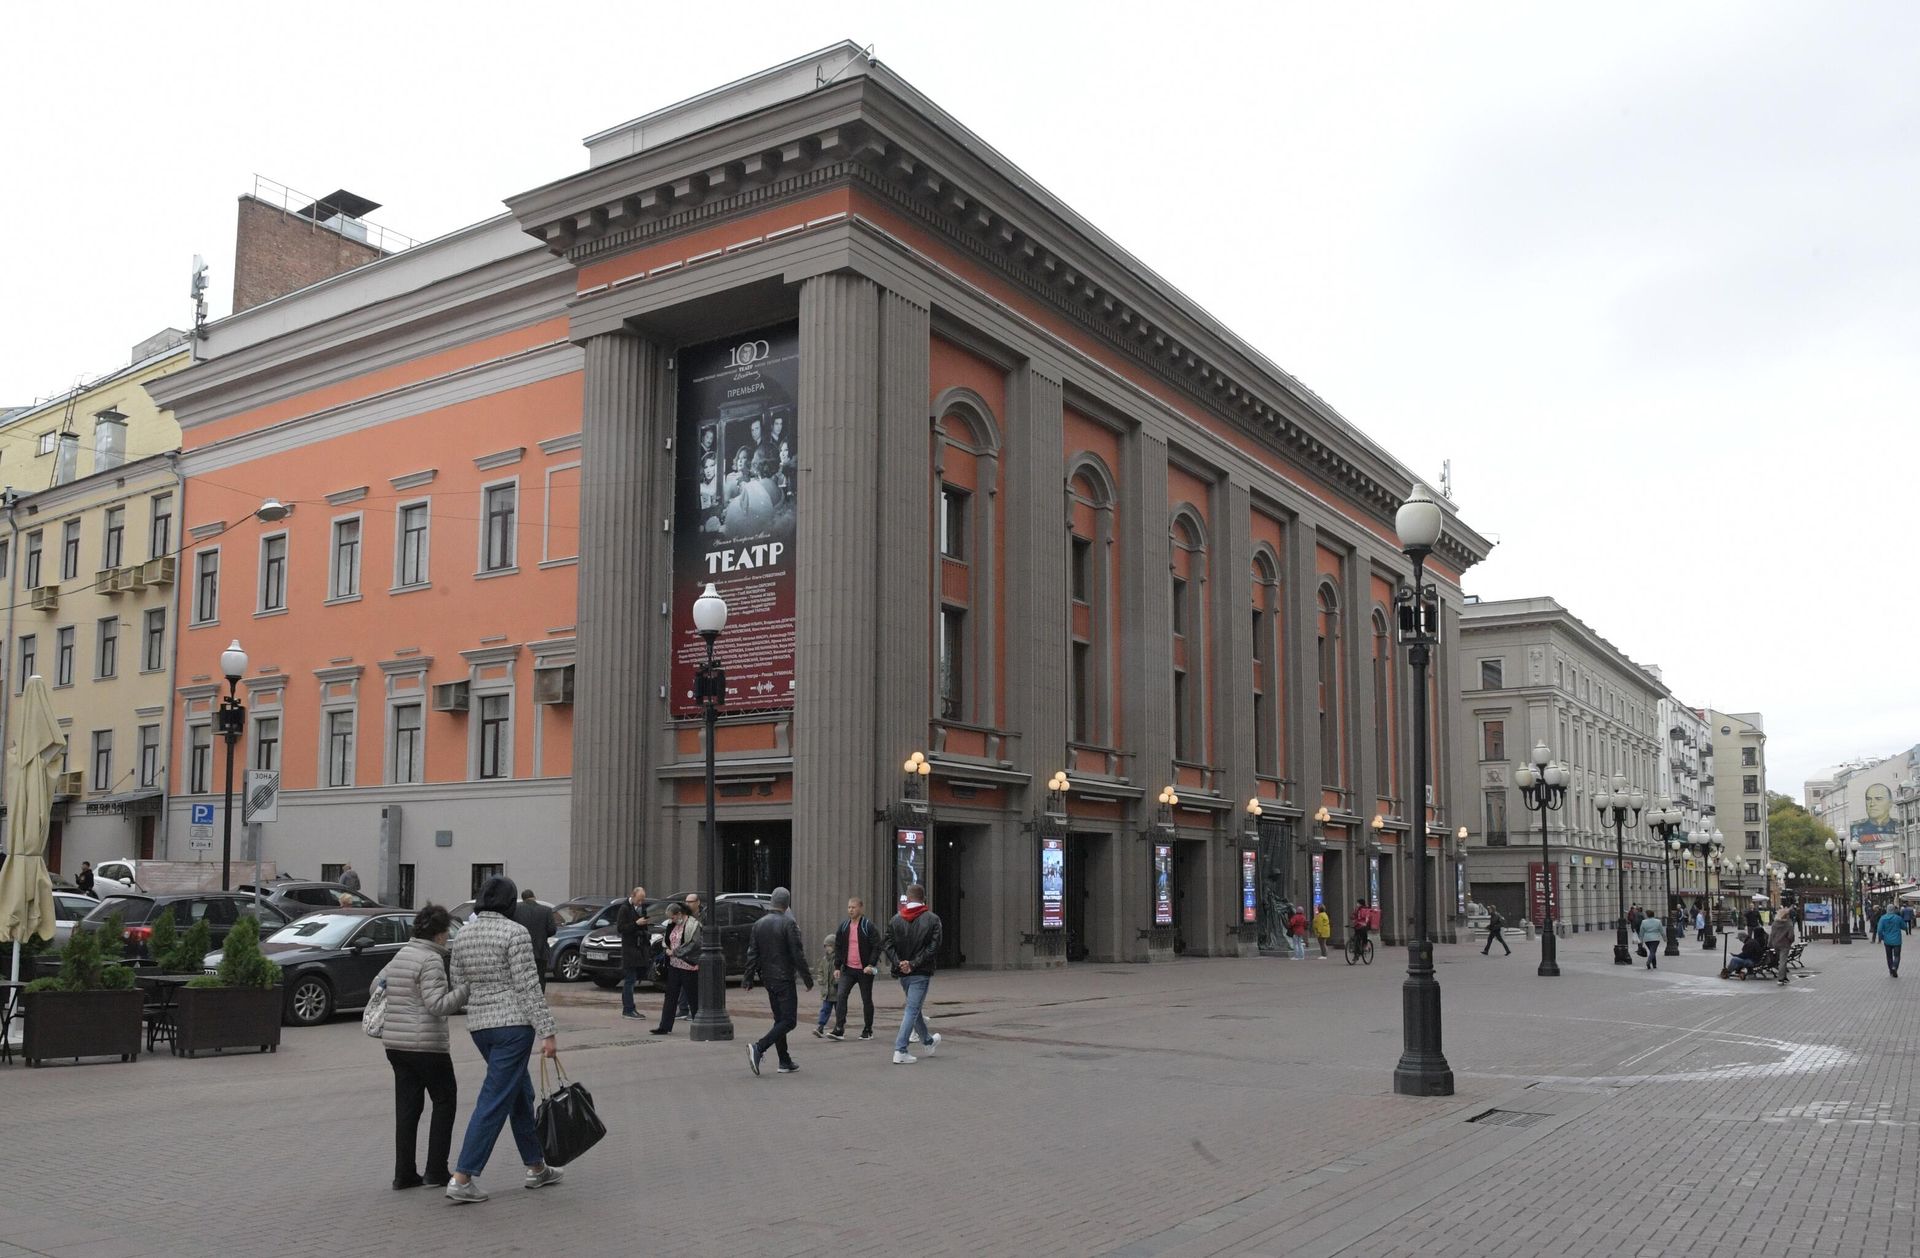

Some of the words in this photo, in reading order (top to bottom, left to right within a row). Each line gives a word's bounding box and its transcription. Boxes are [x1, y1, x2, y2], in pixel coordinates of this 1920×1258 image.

[724, 340, 769, 367] 100
[727, 382, 765, 398] ПРЕМЬЕРА
[705, 541, 784, 574] ТЕАТР
[194, 805, 208, 823] P
